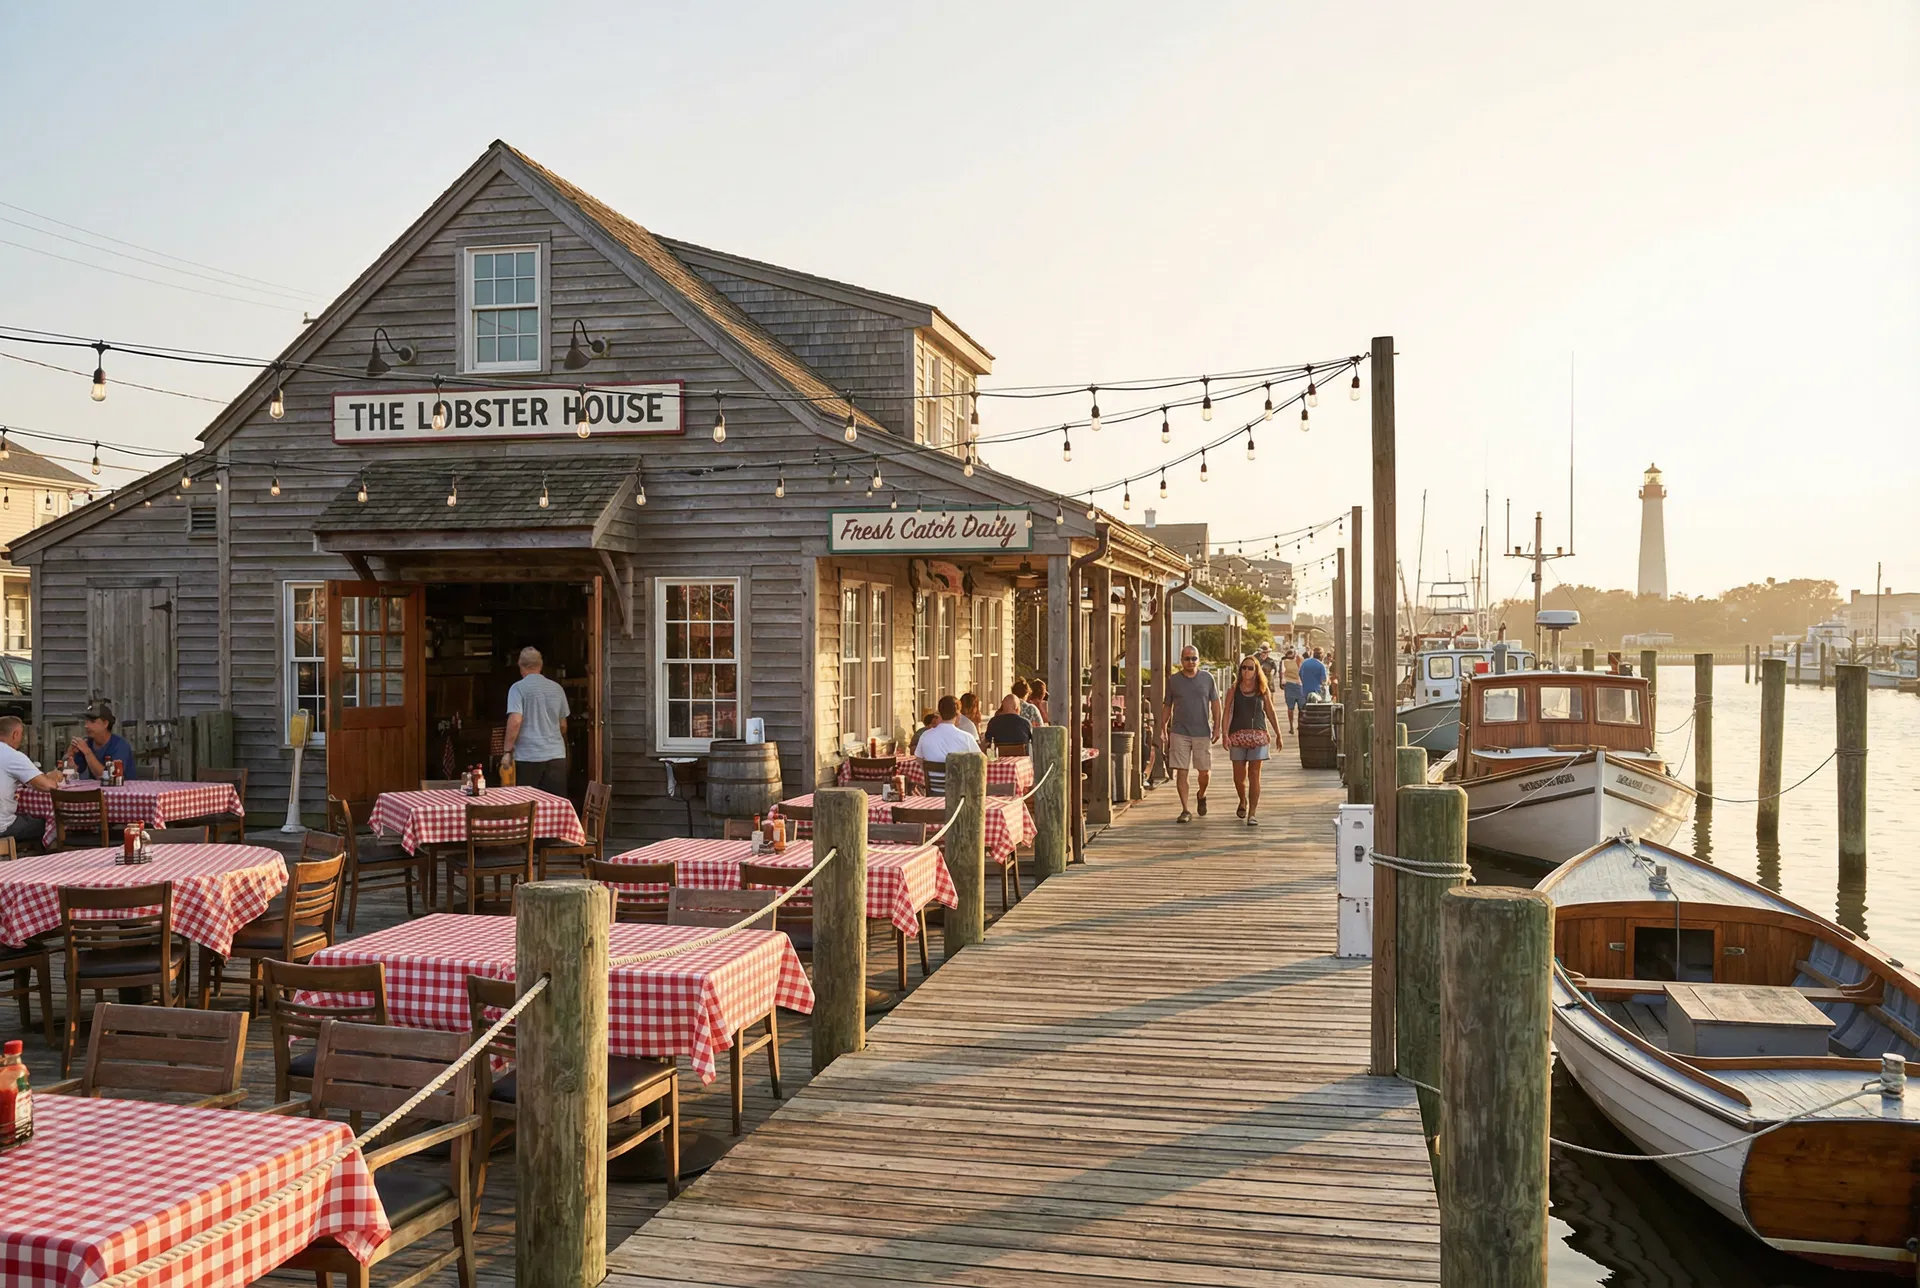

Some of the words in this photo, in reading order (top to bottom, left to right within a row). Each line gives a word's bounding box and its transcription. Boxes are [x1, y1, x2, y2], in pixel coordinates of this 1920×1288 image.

[349, 402, 404, 431] THE
[563, 393, 664, 425] HOUSE
[840, 517, 895, 541] Fresh
[900, 517, 957, 540] Catch
[961, 515, 1017, 548] Daily
